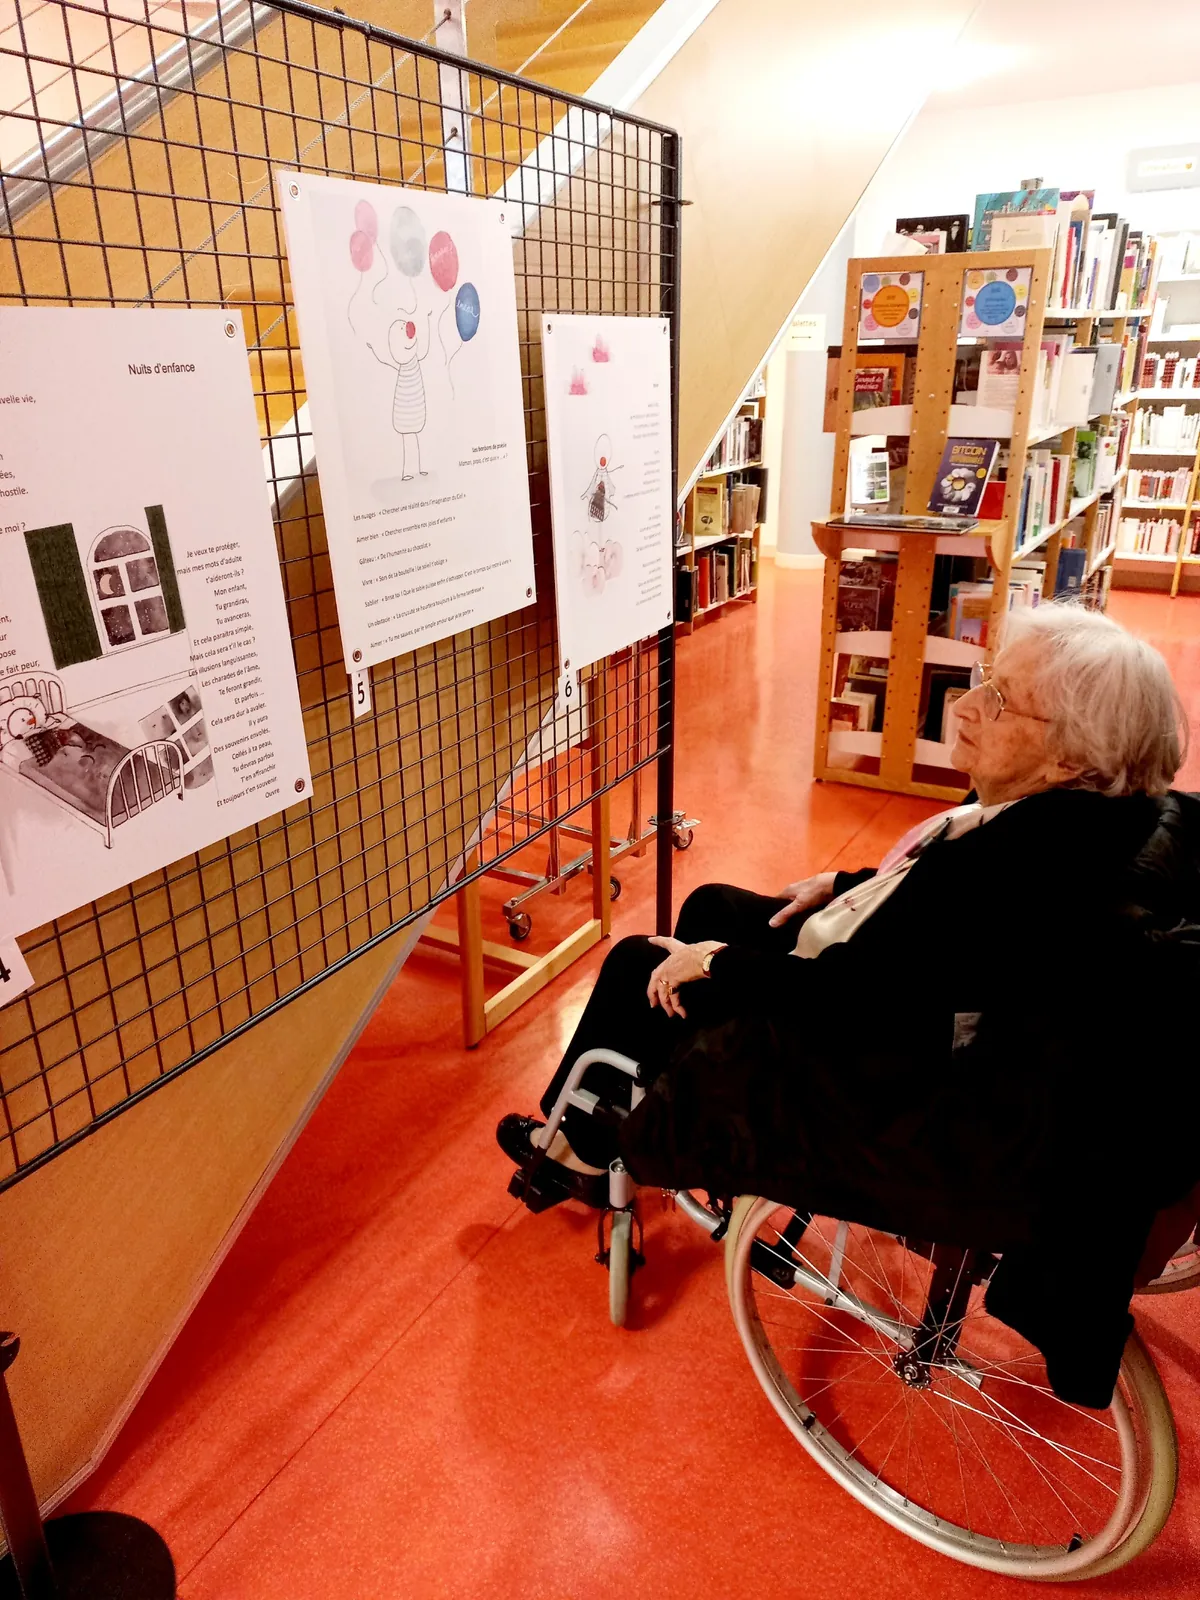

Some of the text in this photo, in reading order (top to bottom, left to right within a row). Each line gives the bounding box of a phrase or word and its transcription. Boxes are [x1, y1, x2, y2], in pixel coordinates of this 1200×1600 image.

[128, 362, 195, 375] Nuits d'enfance
[22, 394, 36, 404] vie,
[952, 445, 987, 455] BITCOIN
[5, 524, 20, 533] moi
[187, 550, 193, 558] Je
[215, 542, 240, 553] protéger,
[177, 567, 191, 575] mais
[205, 561, 219, 569] mots
[220, 556, 242, 565] d'adulte
[205, 570, 241, 583] t'aideront-ils
[214, 583, 247, 596] Mon enfant,
[215, 598, 249, 611] Tu grandiras,
[224, 612, 251, 624] avanceras,
[200, 636, 212, 644] cela
[189, 653, 204, 662] Mais
[204, 649, 216, 658] cela
[217, 646, 229, 654] sera
[6, 664, 20, 674] fait
[21, 660, 40, 672] peur,
[199, 662, 222, 673] illusions
[222, 652, 258, 666] languissantes,
[201, 680, 211, 688] Les
[212, 671, 236, 684] charades
[226, 683, 243, 693] feront
[357, 681, 365, 704] 5
[565, 680, 572, 697] 6
[241, 692, 258, 703] parfois
[211, 718, 223, 726] Cela
[224, 714, 235, 722] sera
[236, 709, 245, 718] dur
[213, 745, 224, 754] Des
[224, 735, 250, 750] souvenirs
[232, 750, 248, 760] Collés
[258, 740, 273, 750] peau,
[240, 759, 257, 770] devras
[257, 751, 275, 764] parfois
[240, 764, 276, 783] T'en affranchir
[223, 790, 245, 805] toujours
[245, 786, 256, 794] t'en
[256, 776, 277, 790] souvenir
[265, 788, 280, 799] Ouvre
